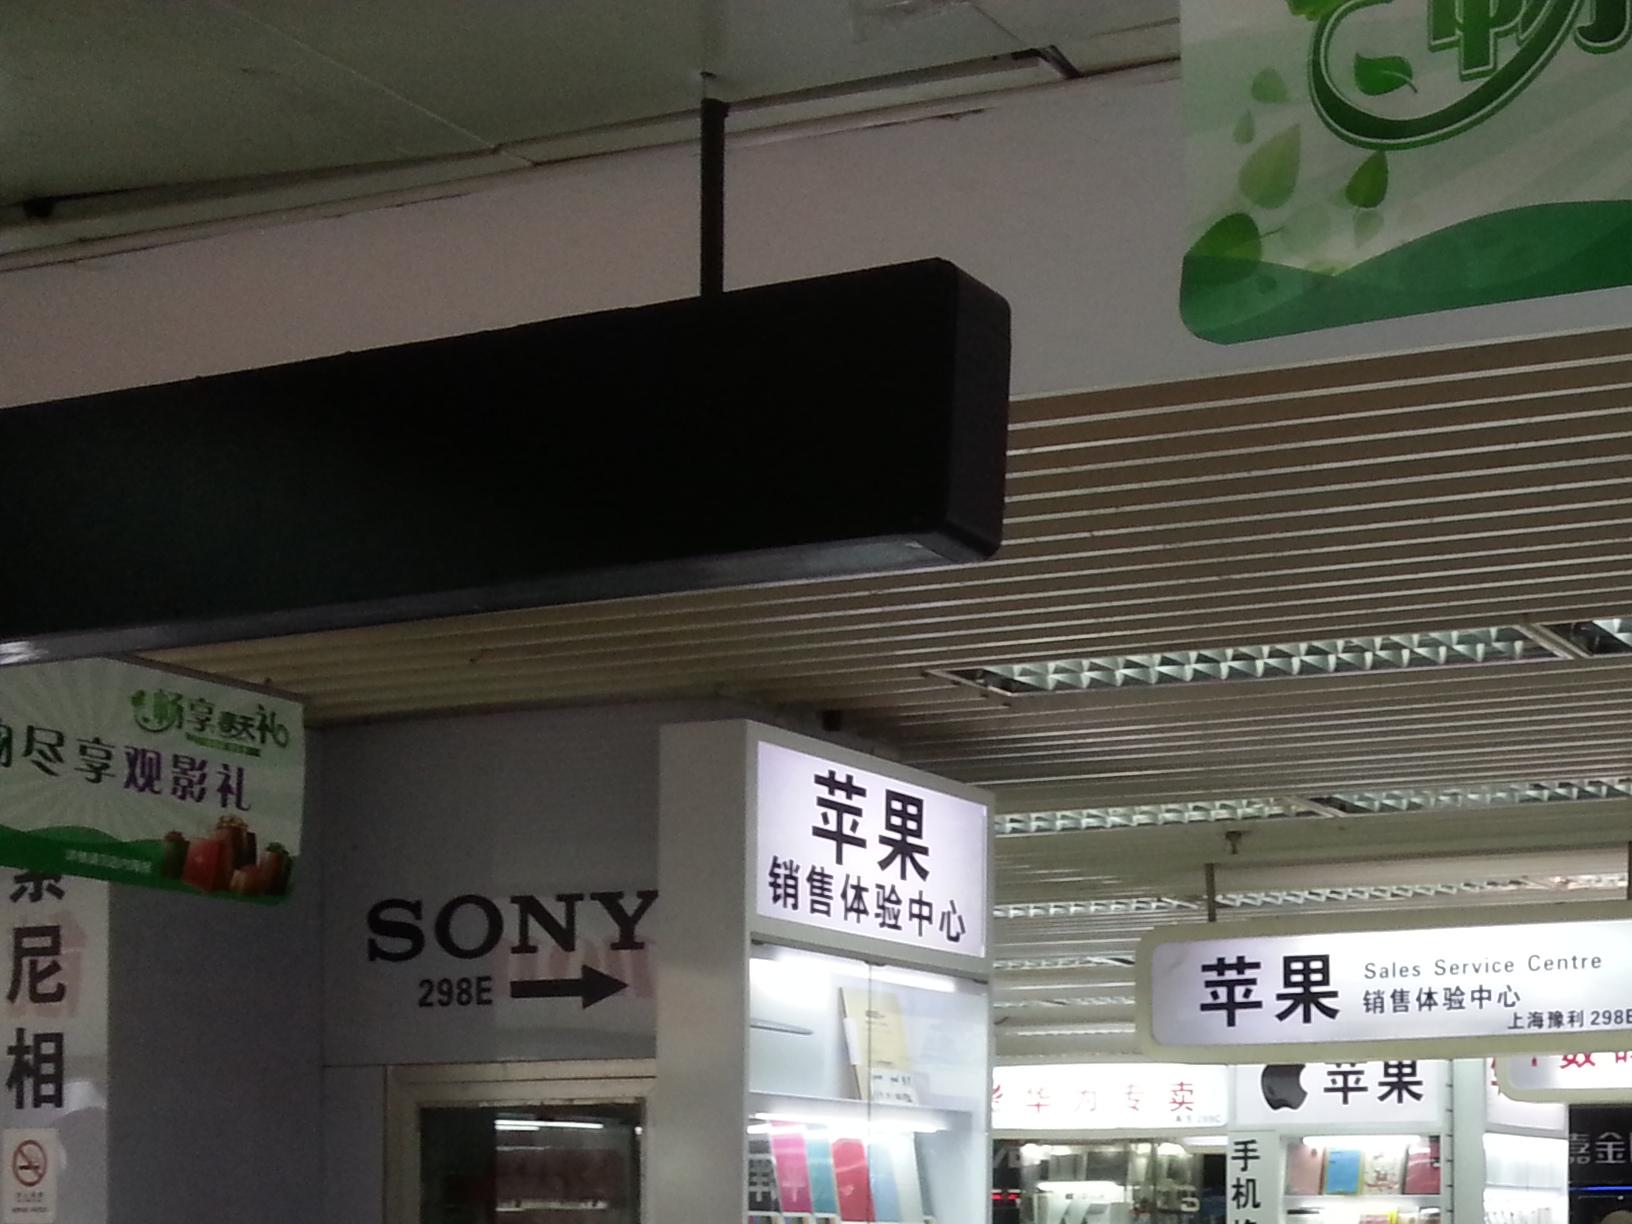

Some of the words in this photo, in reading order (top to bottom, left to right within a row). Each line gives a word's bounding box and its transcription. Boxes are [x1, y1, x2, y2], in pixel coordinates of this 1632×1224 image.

[811, 769, 931, 883] 苹果
[366, 888, 659, 963] SONY
[768, 855, 967, 943] 销售体验中心
[418, 975, 493, 1008] 298E
[1200, 953, 1340, 1028] 苹果
[1363, 961, 1422, 980] Sales
[1434, 956, 1515, 977] Service
[1527, 954, 1603, 972] Centre
[1362, 983, 1521, 1015] 销售体验中心
[1323, 1060, 1424, 1105] 苹果
